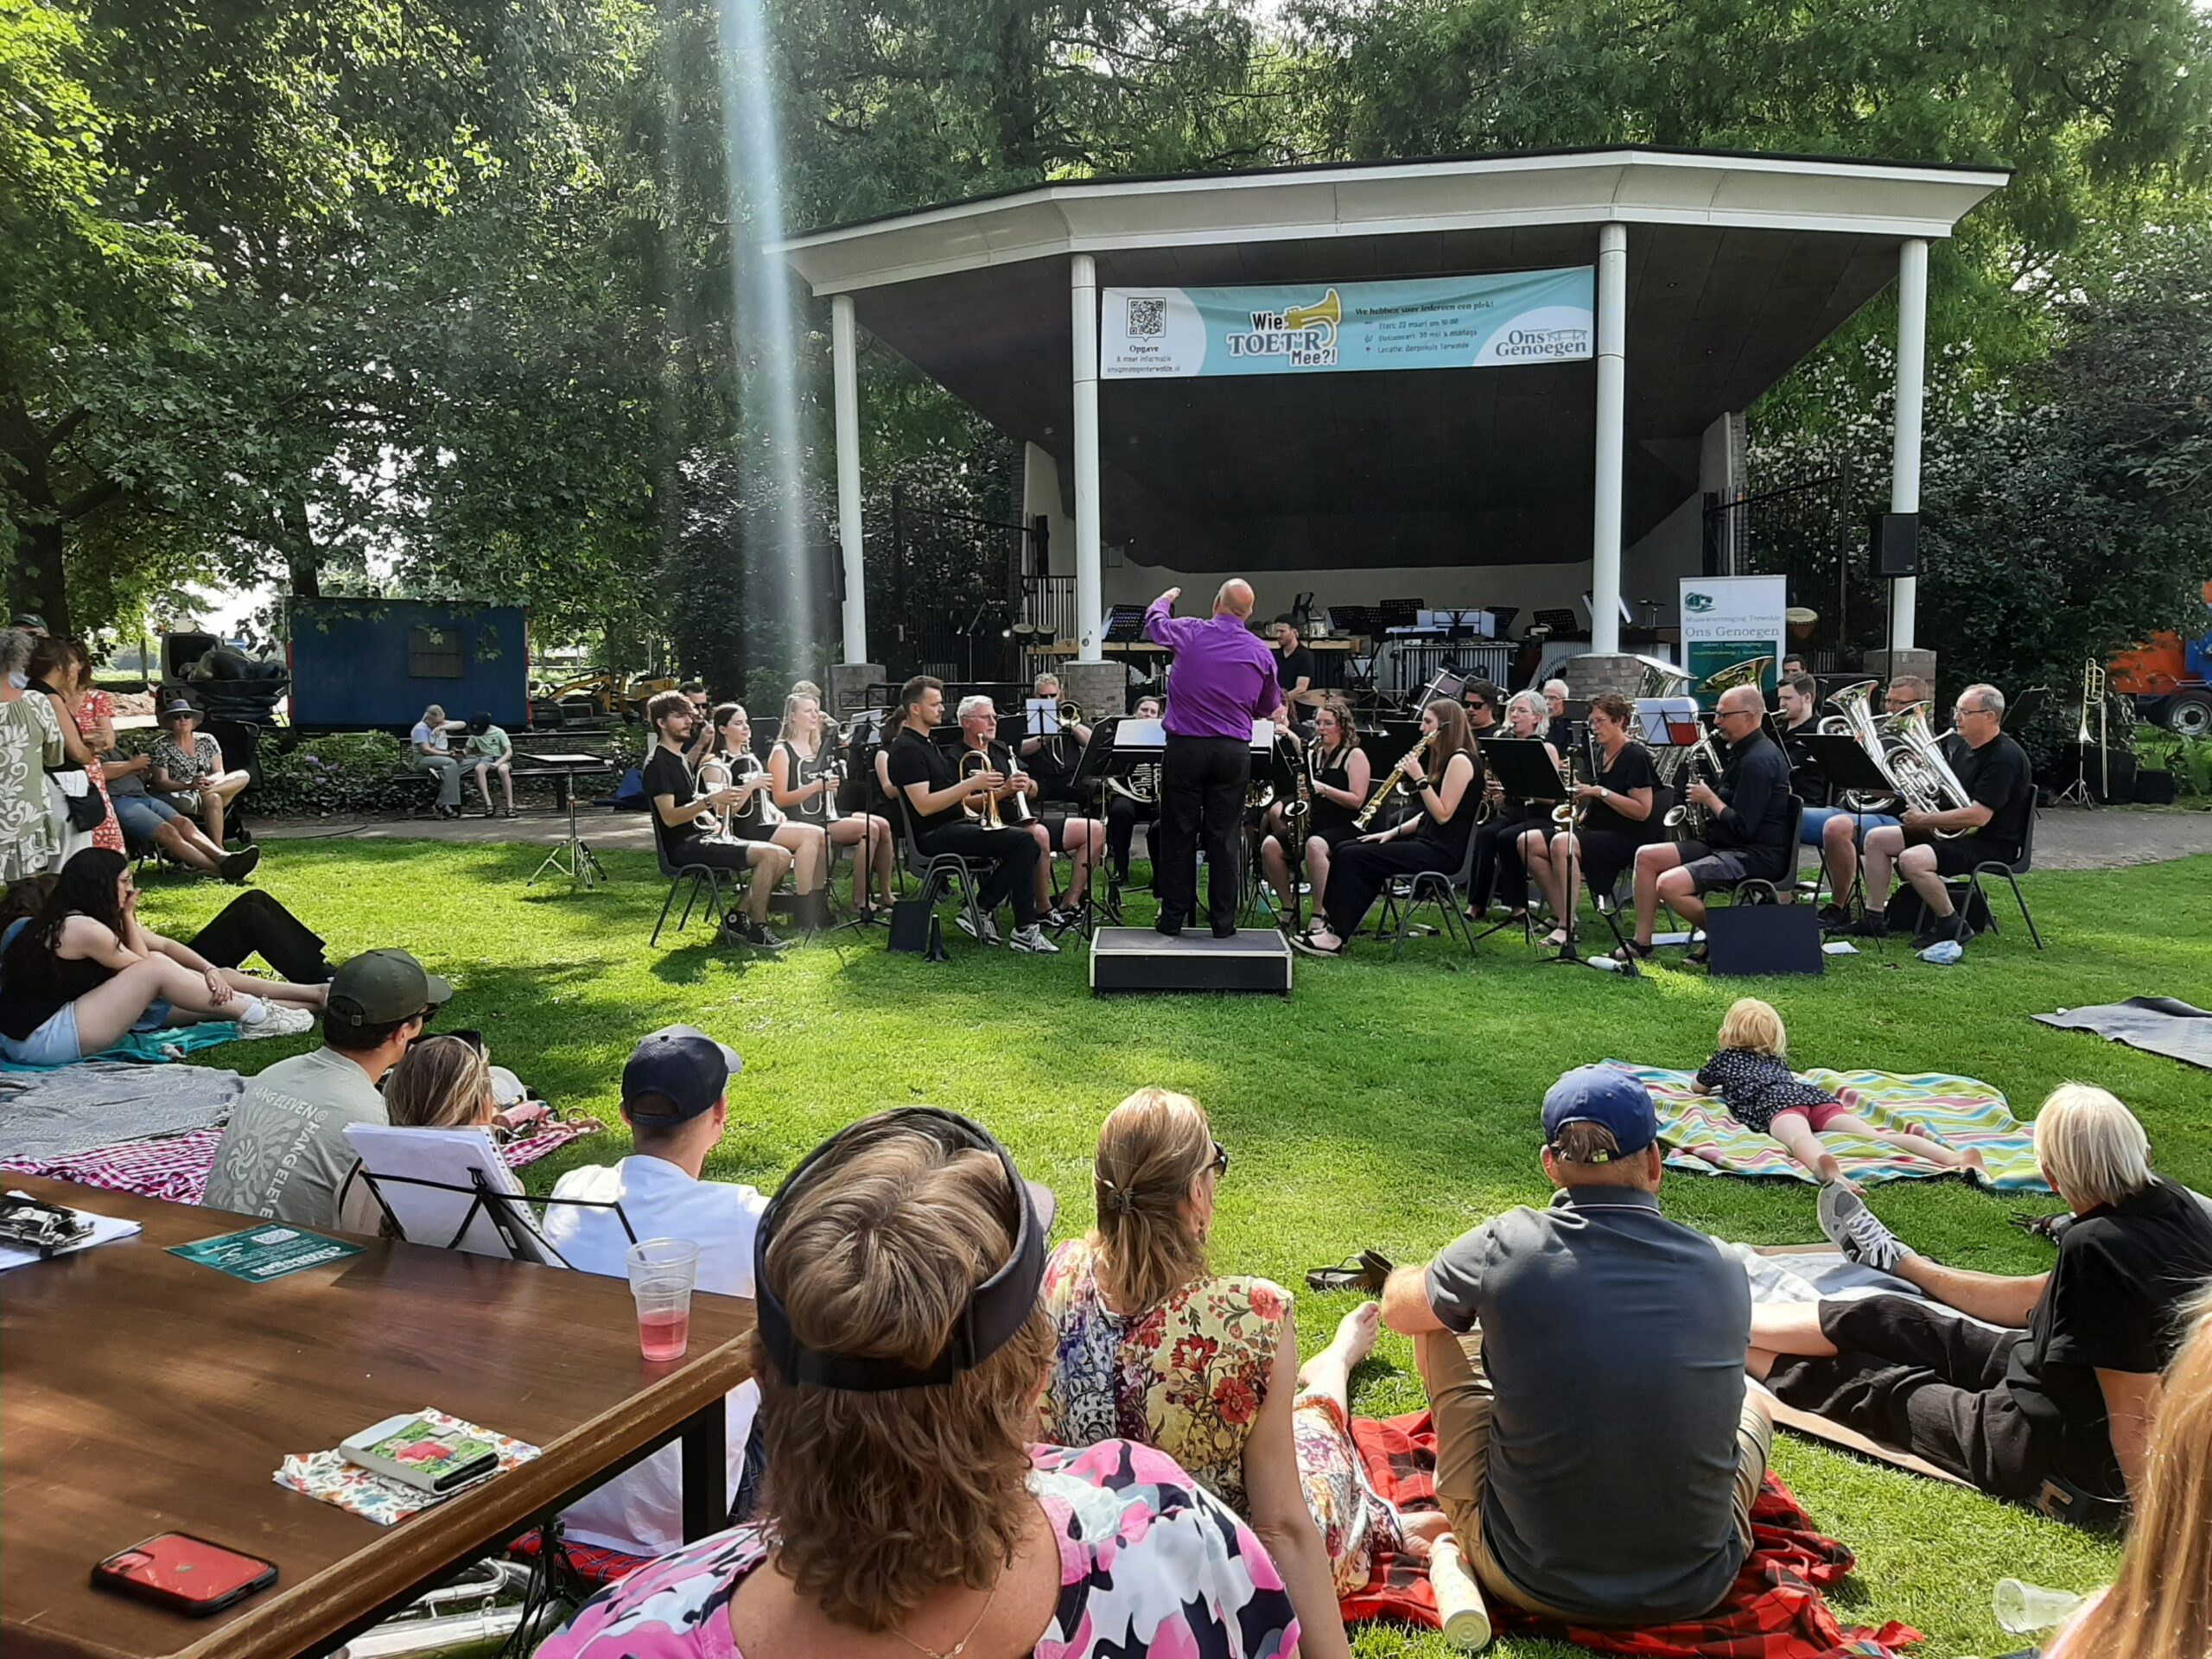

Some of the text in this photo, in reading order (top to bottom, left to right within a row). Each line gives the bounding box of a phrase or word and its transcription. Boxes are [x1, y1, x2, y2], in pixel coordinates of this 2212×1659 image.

[1356, 308, 1368, 316] We
[1370, 306, 1399, 315] hebben
[1421, 302, 1455, 313] iedereen
[1473, 301, 1494, 311] plek!
[1252, 312, 1282, 330] Wie
[1378, 321, 1396, 330] Start:
[1408, 320, 1427, 328] maart
[1228, 332, 1321, 354] TOET'R
[1508, 330, 1545, 346] Ons
[1129, 345, 1160, 353] Opgave
[1291, 349, 1336, 365] Mee?!
[1495, 341, 1586, 357] Genoegen
[1685, 626, 1779, 639] Ons Genoegen
